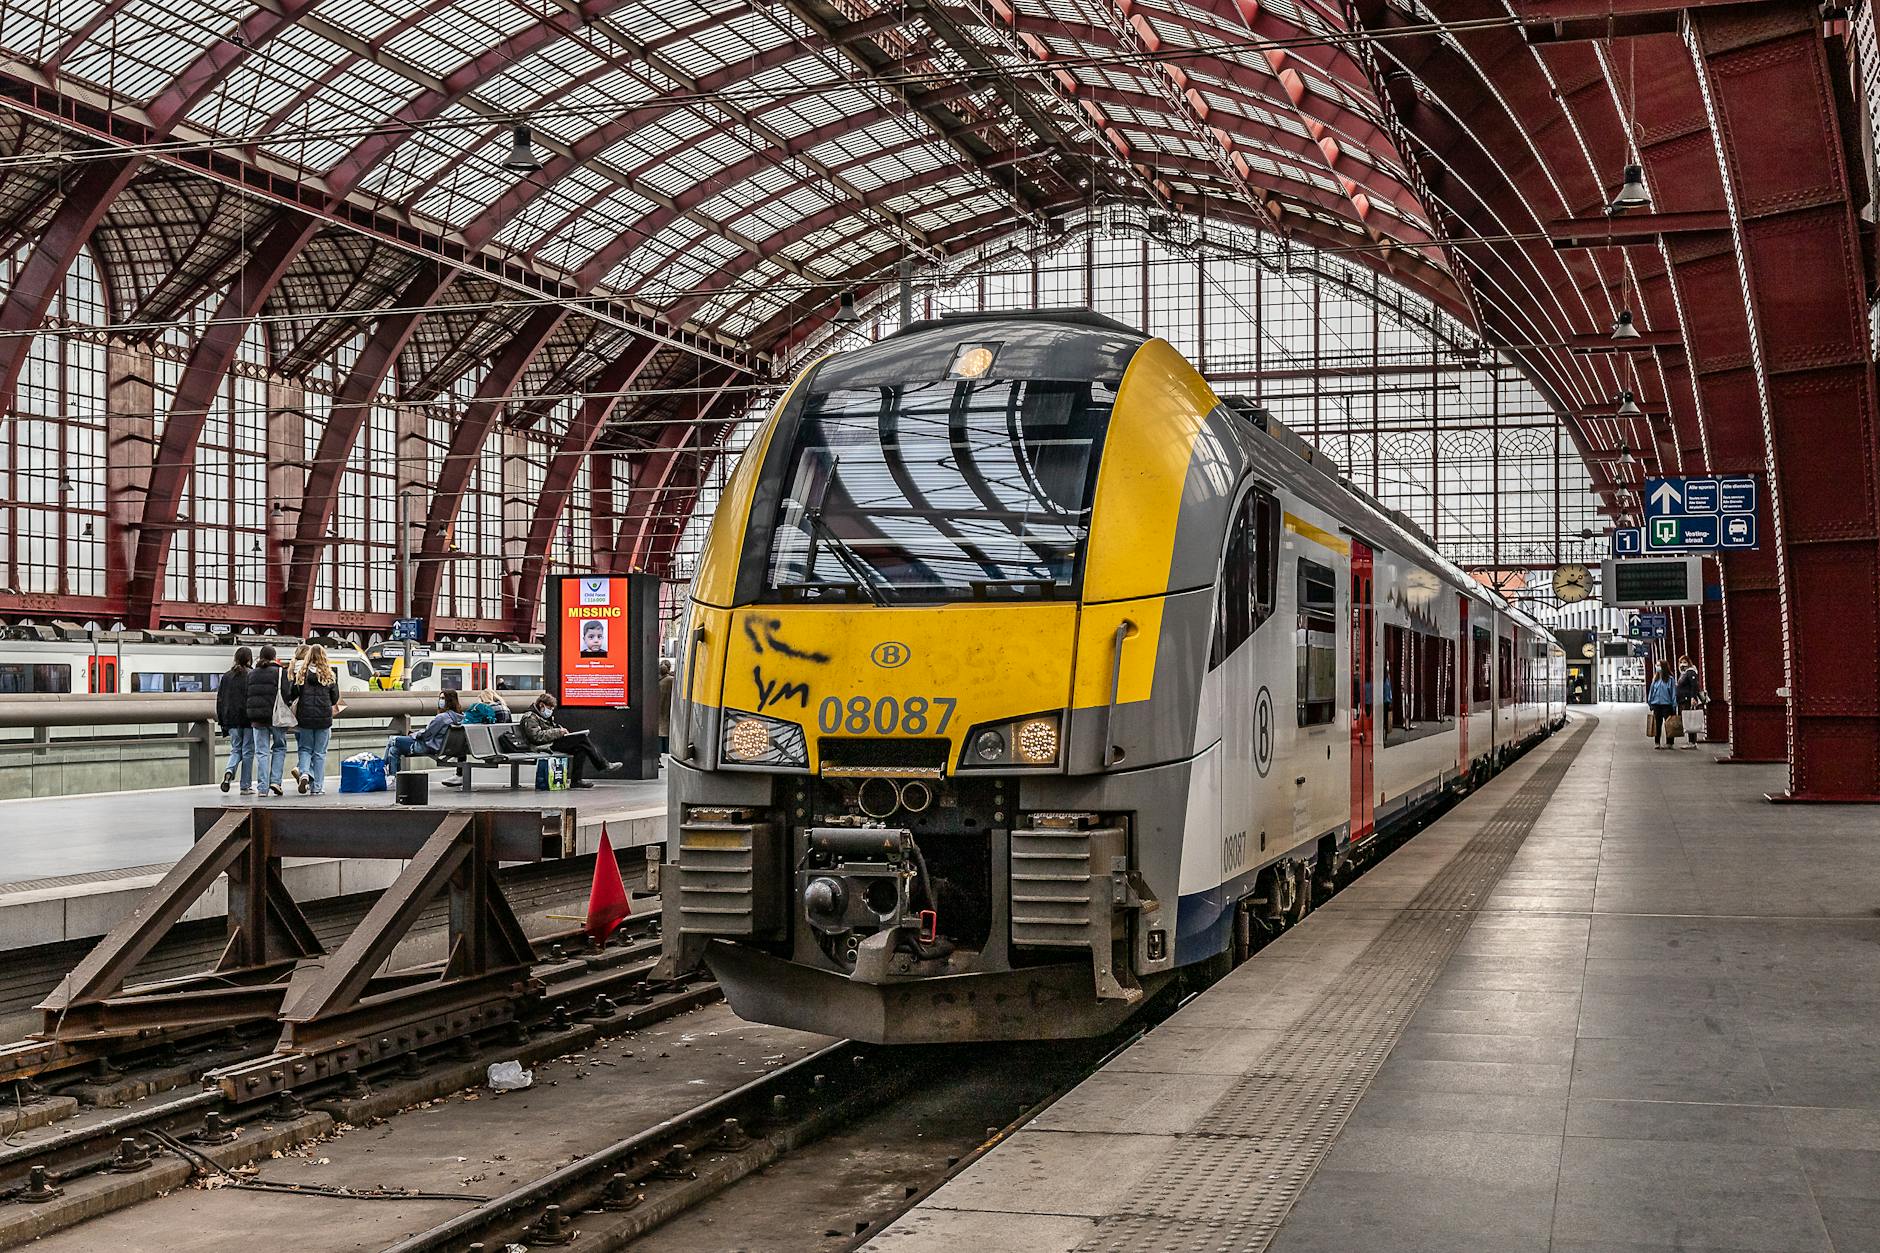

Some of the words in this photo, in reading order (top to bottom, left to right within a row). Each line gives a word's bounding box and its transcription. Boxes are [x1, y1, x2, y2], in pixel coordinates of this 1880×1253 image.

[1623, 535, 1630, 550] 1
[568, 607, 621, 618] MISSING
[881, 645, 901, 665] B
[81, 669, 86, 678] 2
[818, 695, 957, 736] 08087
[1223, 830, 1247, 874] 08087
